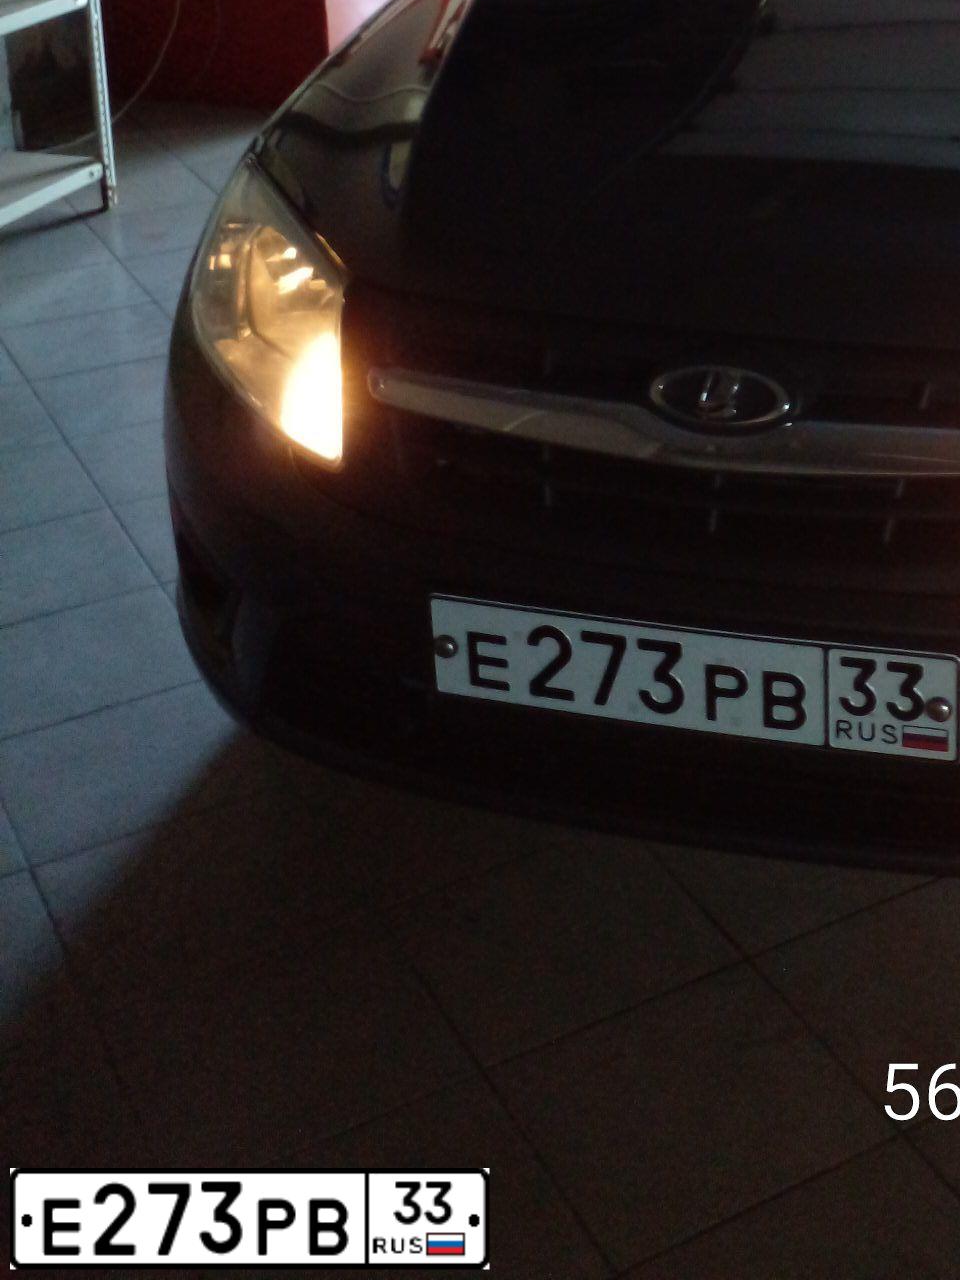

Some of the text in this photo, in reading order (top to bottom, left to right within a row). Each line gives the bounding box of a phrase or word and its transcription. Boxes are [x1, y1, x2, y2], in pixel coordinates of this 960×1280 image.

[465, 624, 925, 731] Е273РВ 33
[835, 719, 899, 745] RUS
